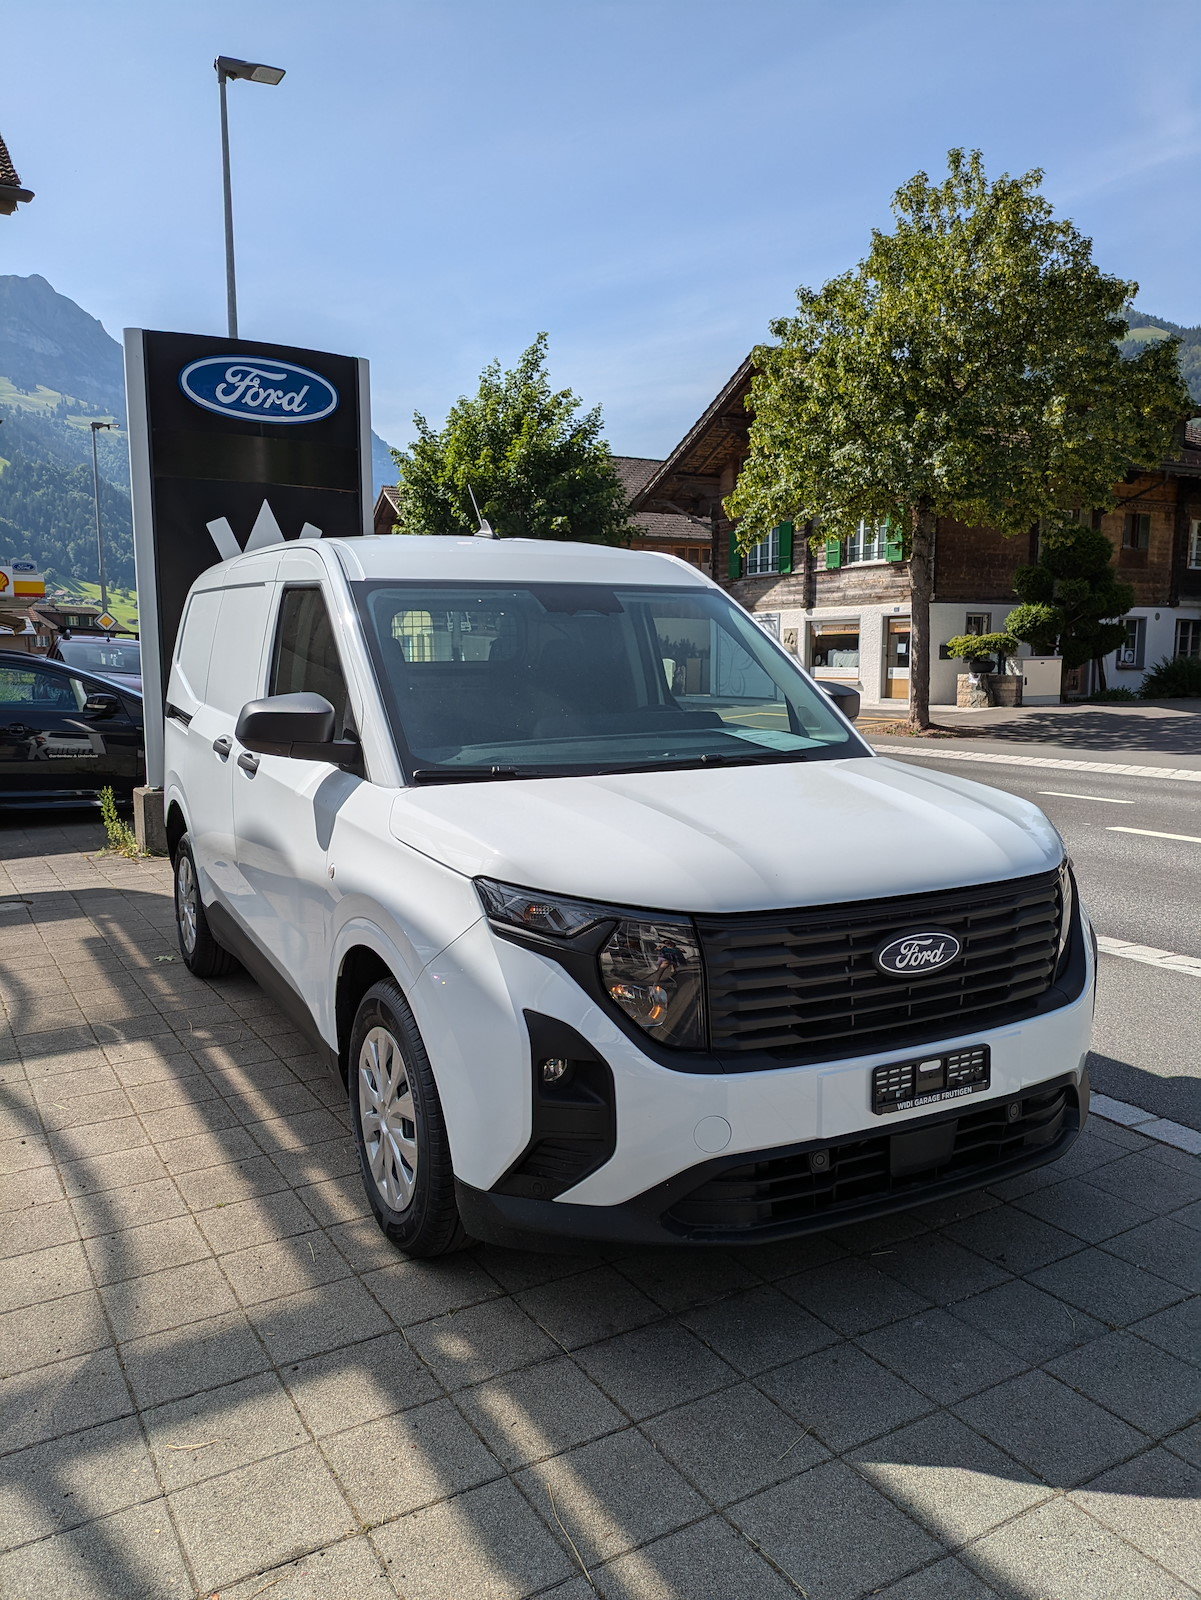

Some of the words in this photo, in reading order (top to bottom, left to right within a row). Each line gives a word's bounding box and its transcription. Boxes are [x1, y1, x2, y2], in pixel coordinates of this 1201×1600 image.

[215, 365, 310, 413] Ford
[895, 938, 946, 969] Ford
[896, 1099, 913, 1110] WIDI
[914, 1094, 941, 1106] GARAGE
[941, 1086, 973, 1100] FRUTIGEN
